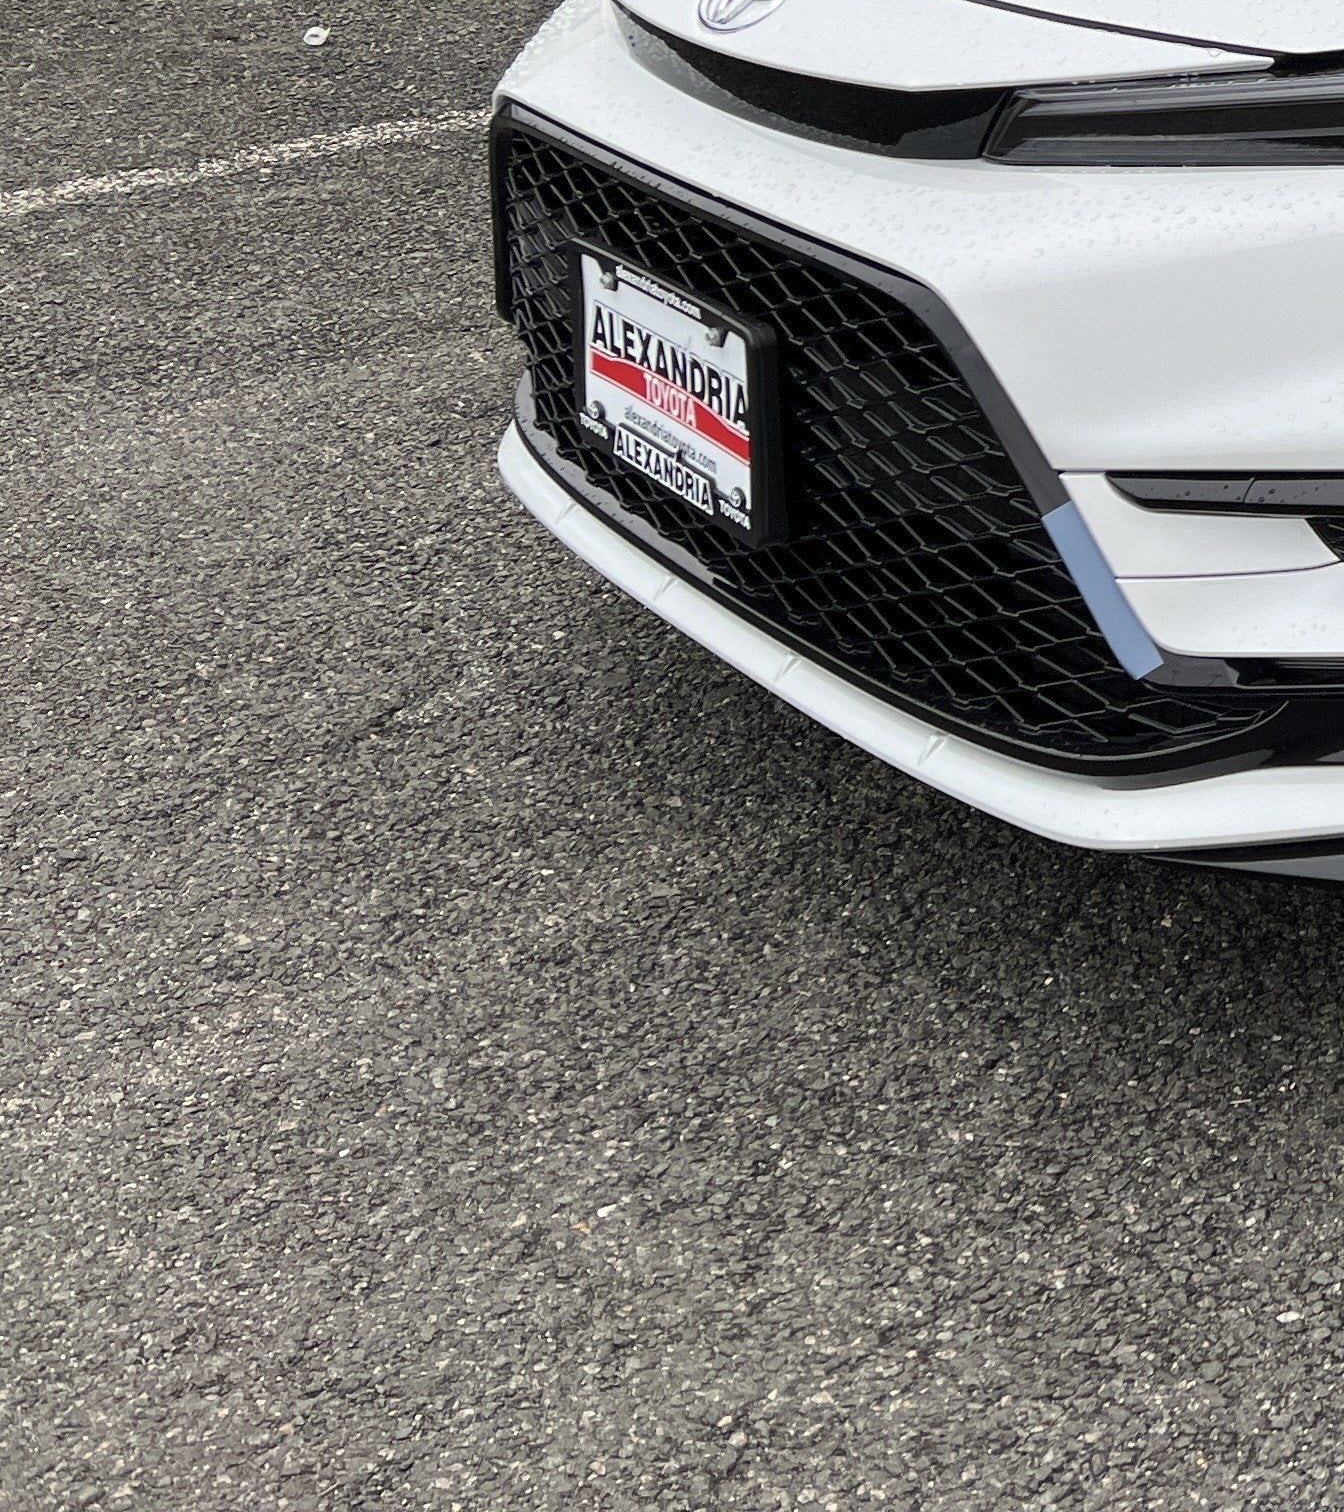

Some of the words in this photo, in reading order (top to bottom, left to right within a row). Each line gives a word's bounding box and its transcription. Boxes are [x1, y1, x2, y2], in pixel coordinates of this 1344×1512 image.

[592, 306, 749, 428] ALEXANDRIA
[579, 412, 609, 440] TOYOTA
[643, 373, 698, 428] TOYOTA
[616, 430, 713, 514] ALEXANDRIA
[719, 499, 752, 531] TOYOTA
